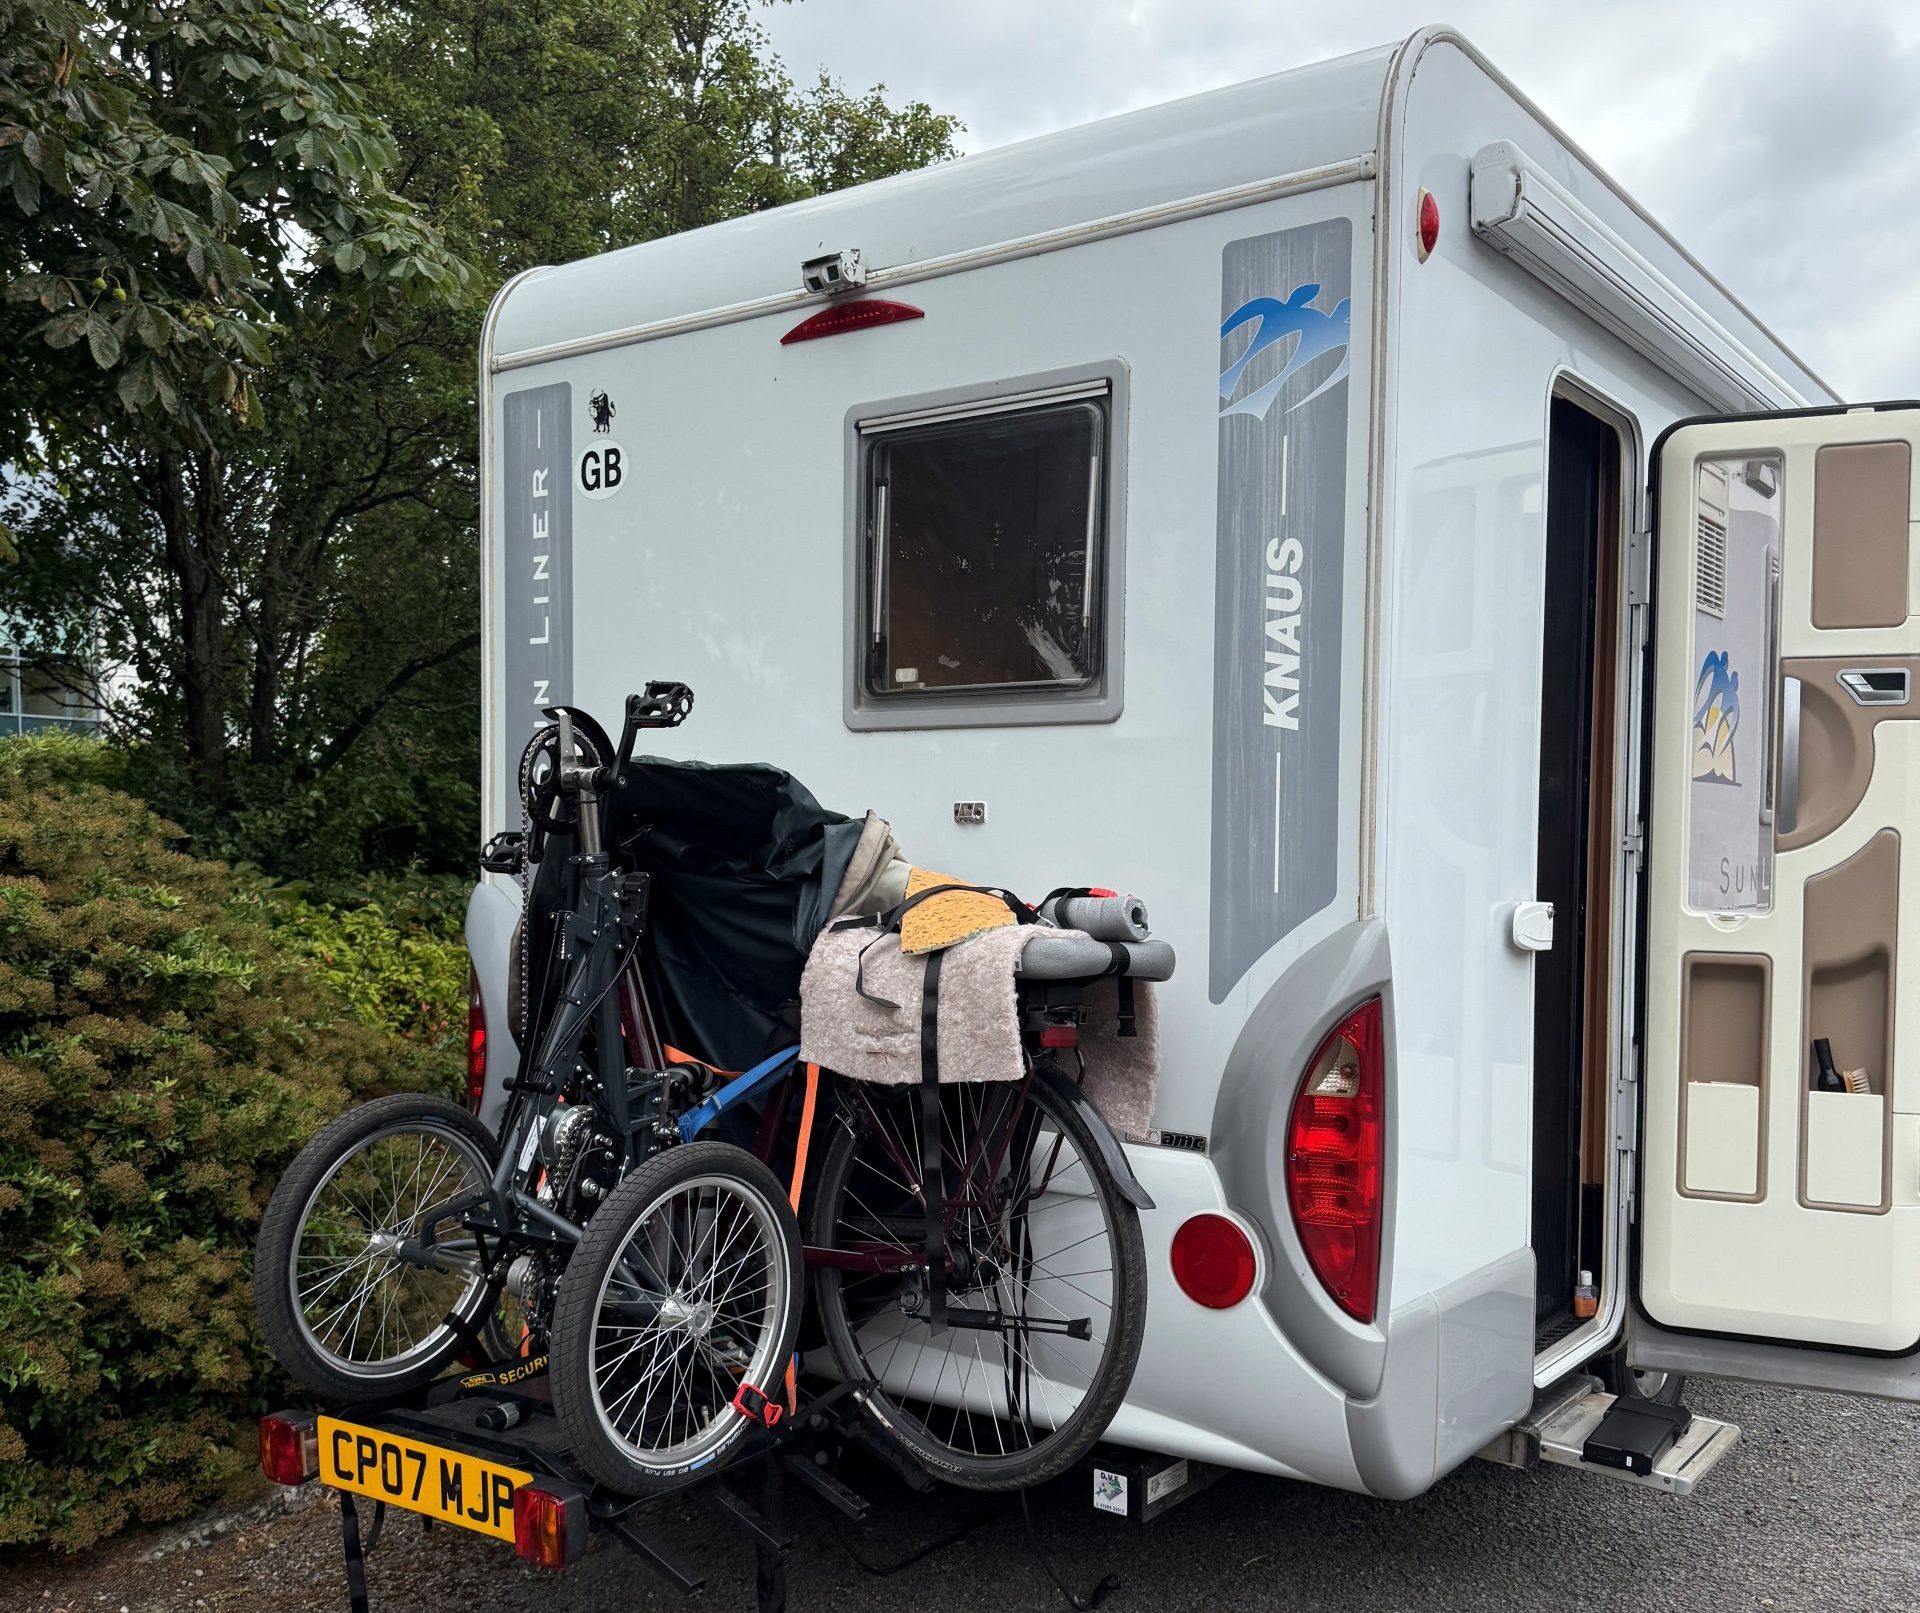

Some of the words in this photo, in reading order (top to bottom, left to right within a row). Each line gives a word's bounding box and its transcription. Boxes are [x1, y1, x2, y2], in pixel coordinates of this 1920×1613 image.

[581, 447, 622, 491] GB
[530, 467, 549, 644] LINER
[1263, 537, 1304, 731] KNAUS
[499, 1354, 550, 1385] SECURI
[332, 1429, 427, 1502] CP07
[440, 1458, 515, 1528] MJP
